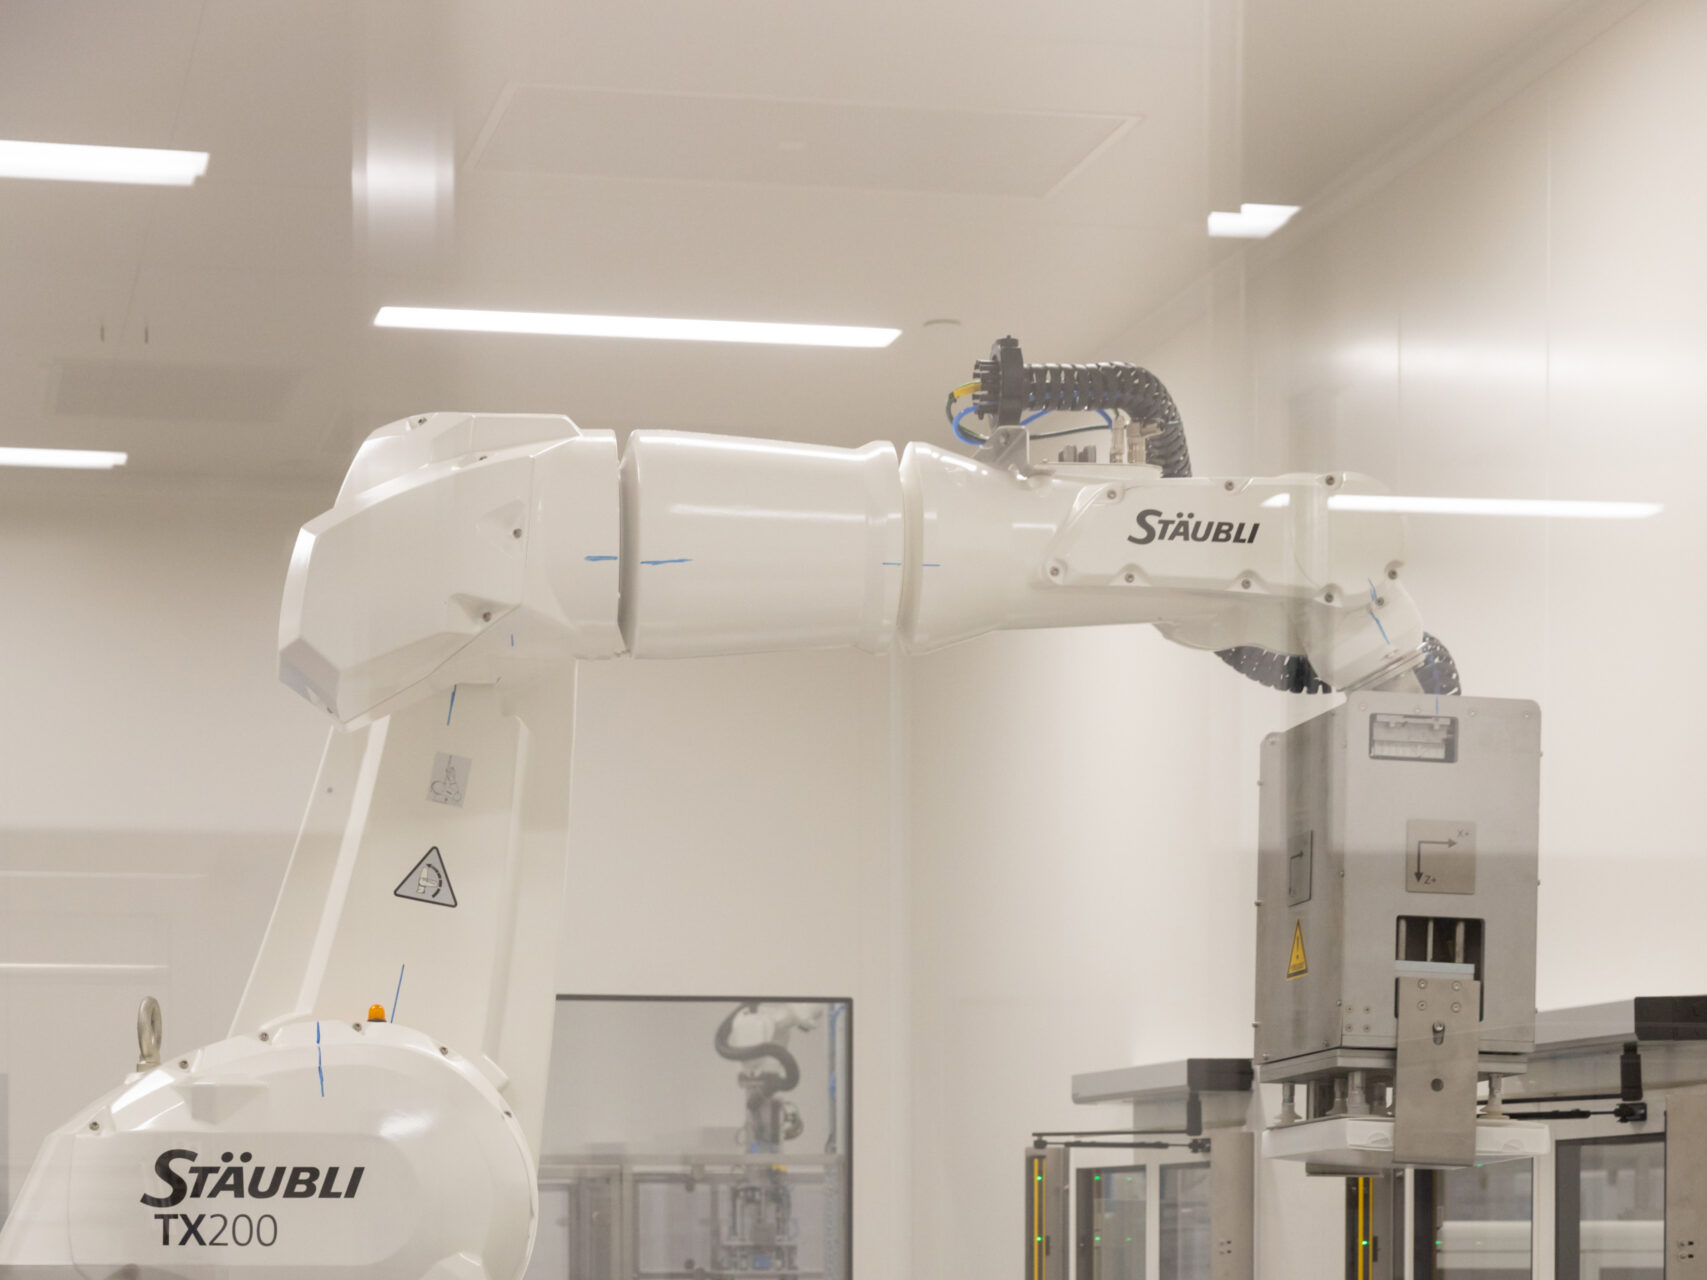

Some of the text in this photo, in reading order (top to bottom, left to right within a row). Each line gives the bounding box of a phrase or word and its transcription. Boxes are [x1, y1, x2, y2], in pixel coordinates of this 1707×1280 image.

[1128, 509, 1260, 545] STÄUBLI
[140, 1149, 365, 1208] STÄUBLI
[154, 1214, 278, 1247] TX200
